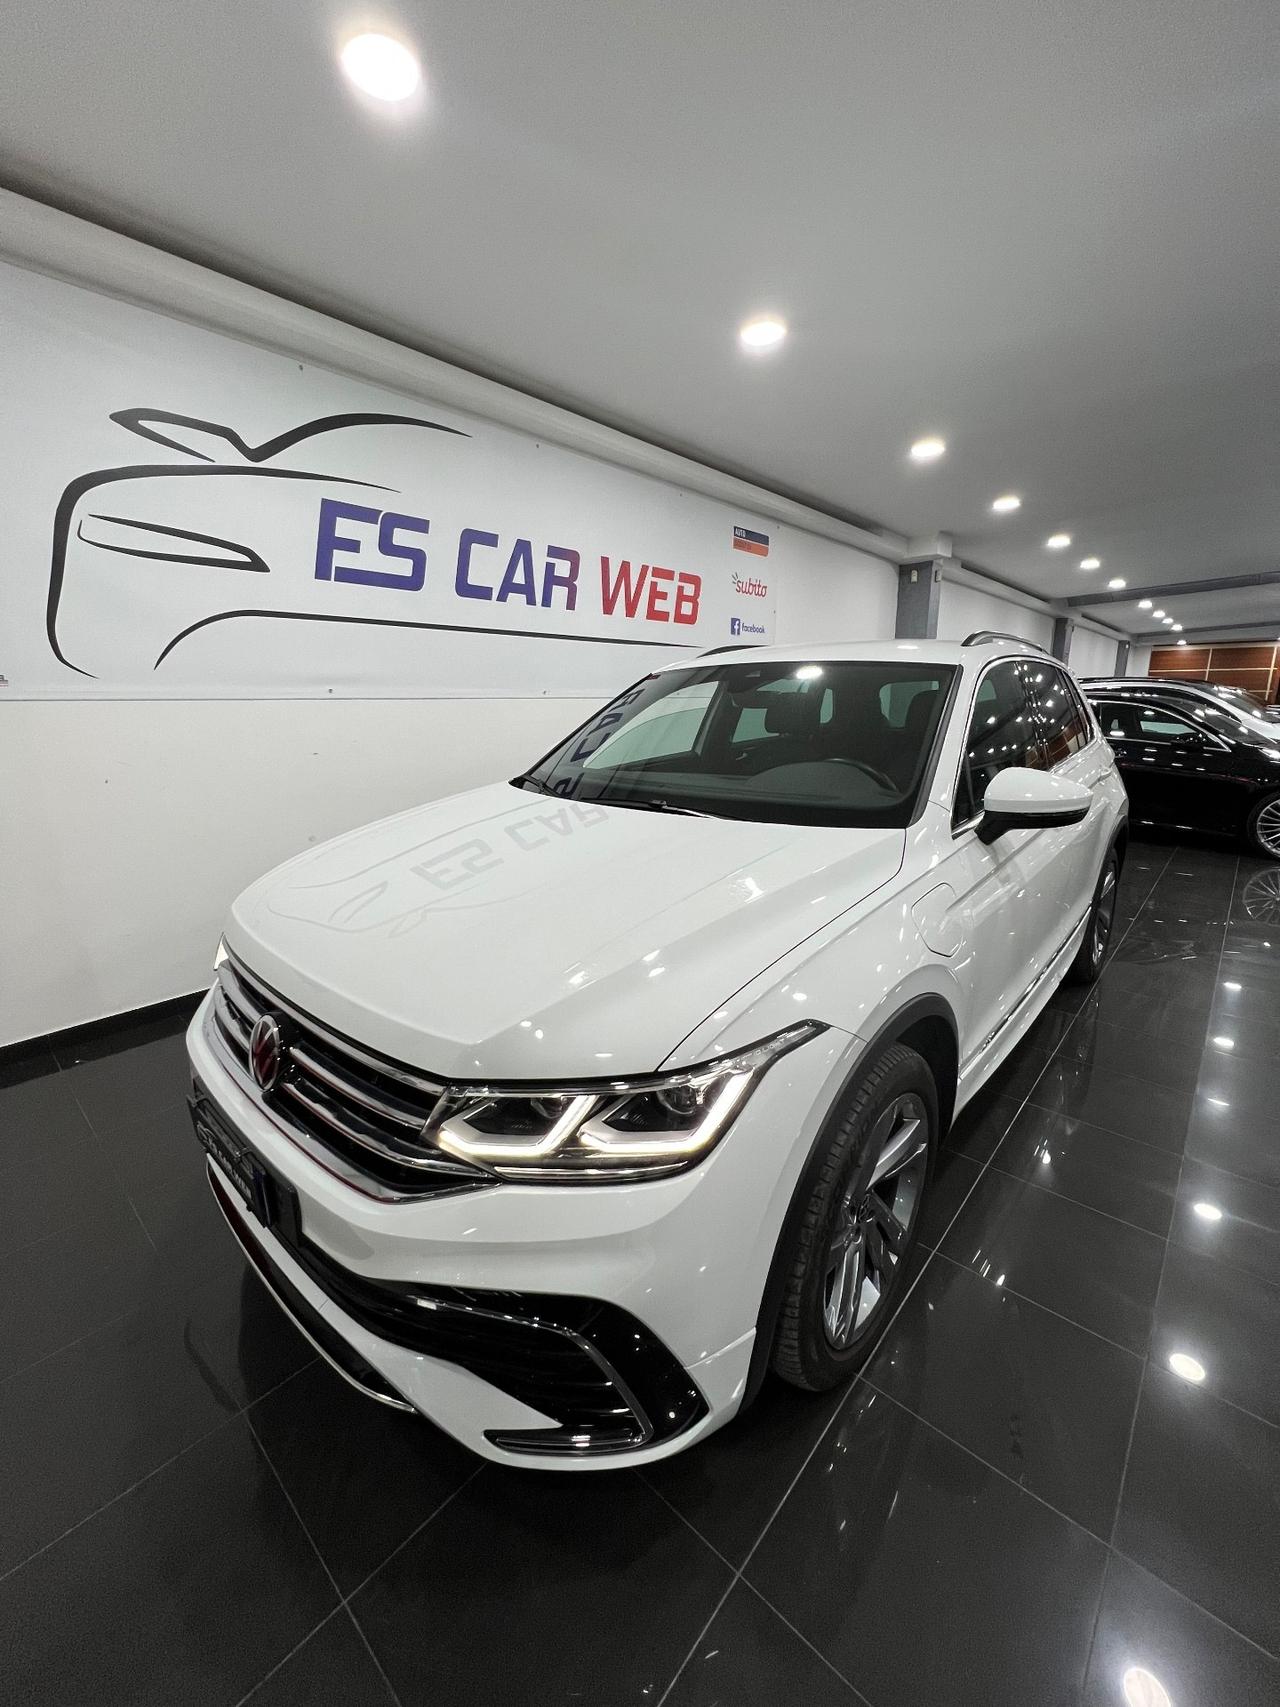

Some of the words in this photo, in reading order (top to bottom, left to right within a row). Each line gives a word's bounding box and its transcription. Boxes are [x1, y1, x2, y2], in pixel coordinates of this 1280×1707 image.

[314, 497, 431, 592] ES
[454, 528, 581, 611] CAR
[600, 555, 702, 626] WEB
[735, 577, 767, 598] subito
[742, 622, 766, 634] facebook
